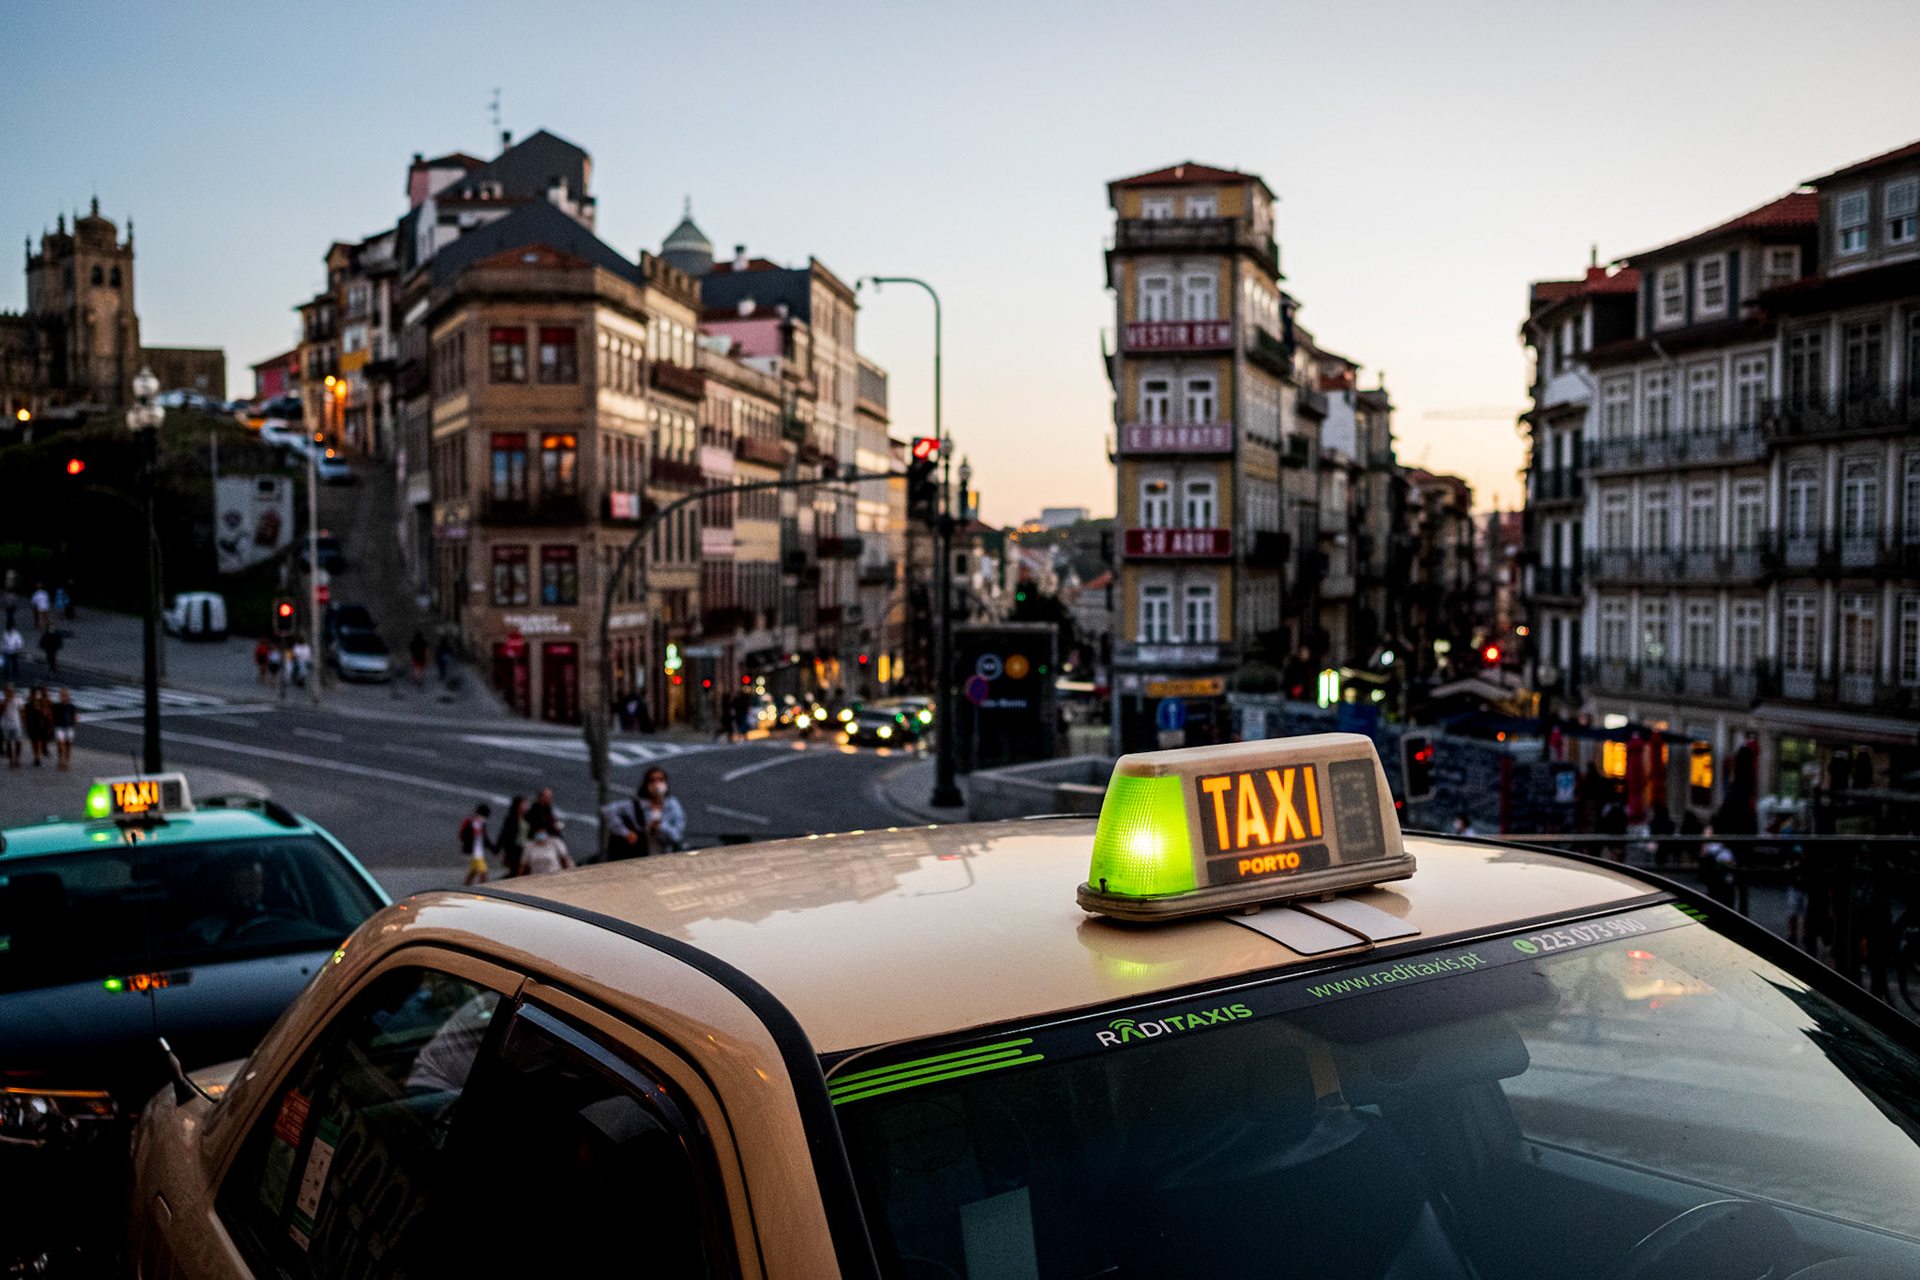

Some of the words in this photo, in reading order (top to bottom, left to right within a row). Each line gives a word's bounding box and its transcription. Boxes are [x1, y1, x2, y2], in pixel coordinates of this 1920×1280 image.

[112, 780, 159, 807] TAXI
[1202, 766, 1323, 850] TAXI
[1238, 851, 1300, 876] PORTO
[1529, 930, 1576, 951] 225
[1570, 923, 1609, 943] 073
[1607, 916, 1647, 936] 900
[1306, 951, 1487, 998] www.raditaxis.pt
[1095, 1003, 1253, 1047] RADITAXIS
